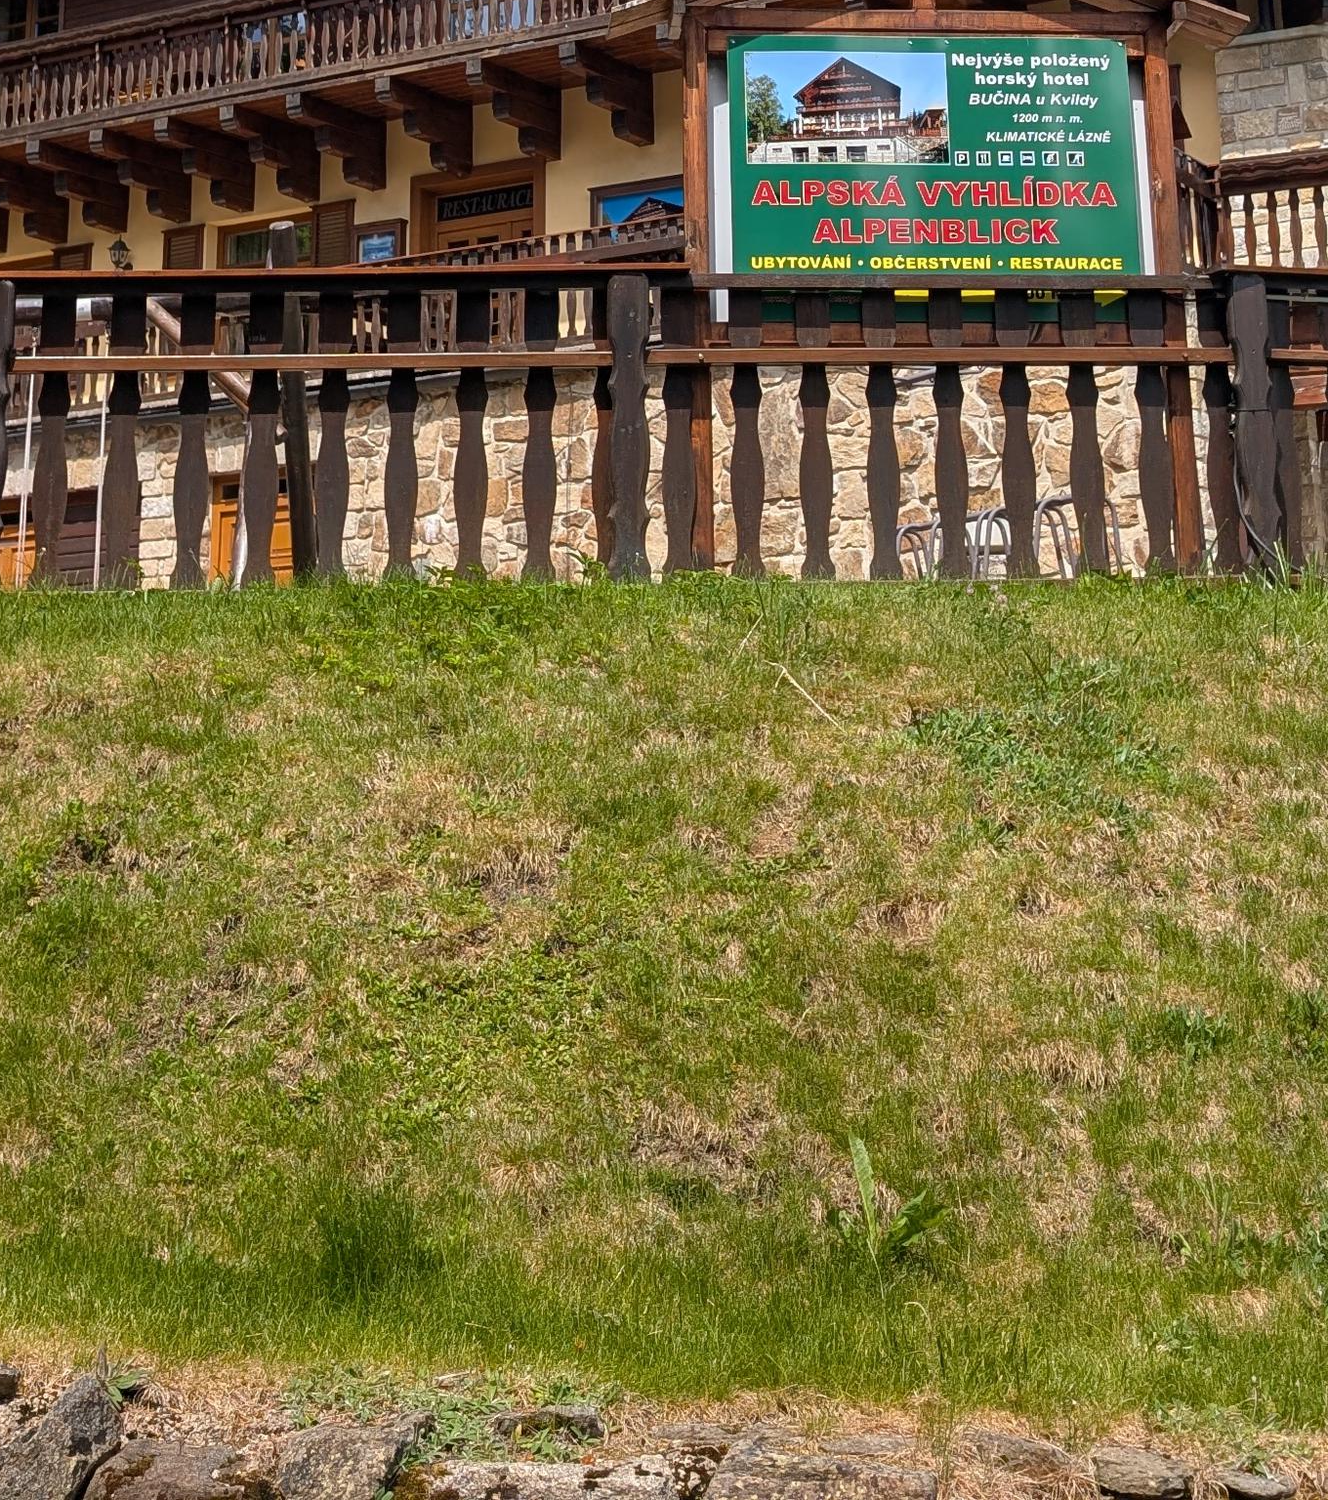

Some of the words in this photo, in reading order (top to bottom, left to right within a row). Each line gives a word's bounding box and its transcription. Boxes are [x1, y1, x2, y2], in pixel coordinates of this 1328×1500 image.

[951, 53, 1024, 69] Nejvýše
[1030, 53, 1110, 71] položený
[975, 72, 1037, 88] horský
[1043, 72, 1089, 85] hotel
[968, 90, 1032, 106] BUČINA
[1035, 95, 1046, 106] u
[1050, 93, 1099, 109] Kvildy
[1011, 113, 1039, 123] 1200
[1041, 115, 1053, 123] m
[1055, 115, 1066, 123] n.
[1069, 115, 1084, 124] m.
[986, 129, 1066, 143] KLIMATICKÉ
[1068, 129, 1112, 143] LÁZNĚ
[751, 175, 907, 206] ALPSKÁ
[915, 175, 1118, 207] VYHLÍDKA
[812, 218, 1060, 245] ALPENBLICK
[751, 254, 852, 270] UBYTOVÁNÍ
[869, 254, 992, 270] OBČERSTVENÍ
[1010, 257, 1123, 271] RESTAURACE
